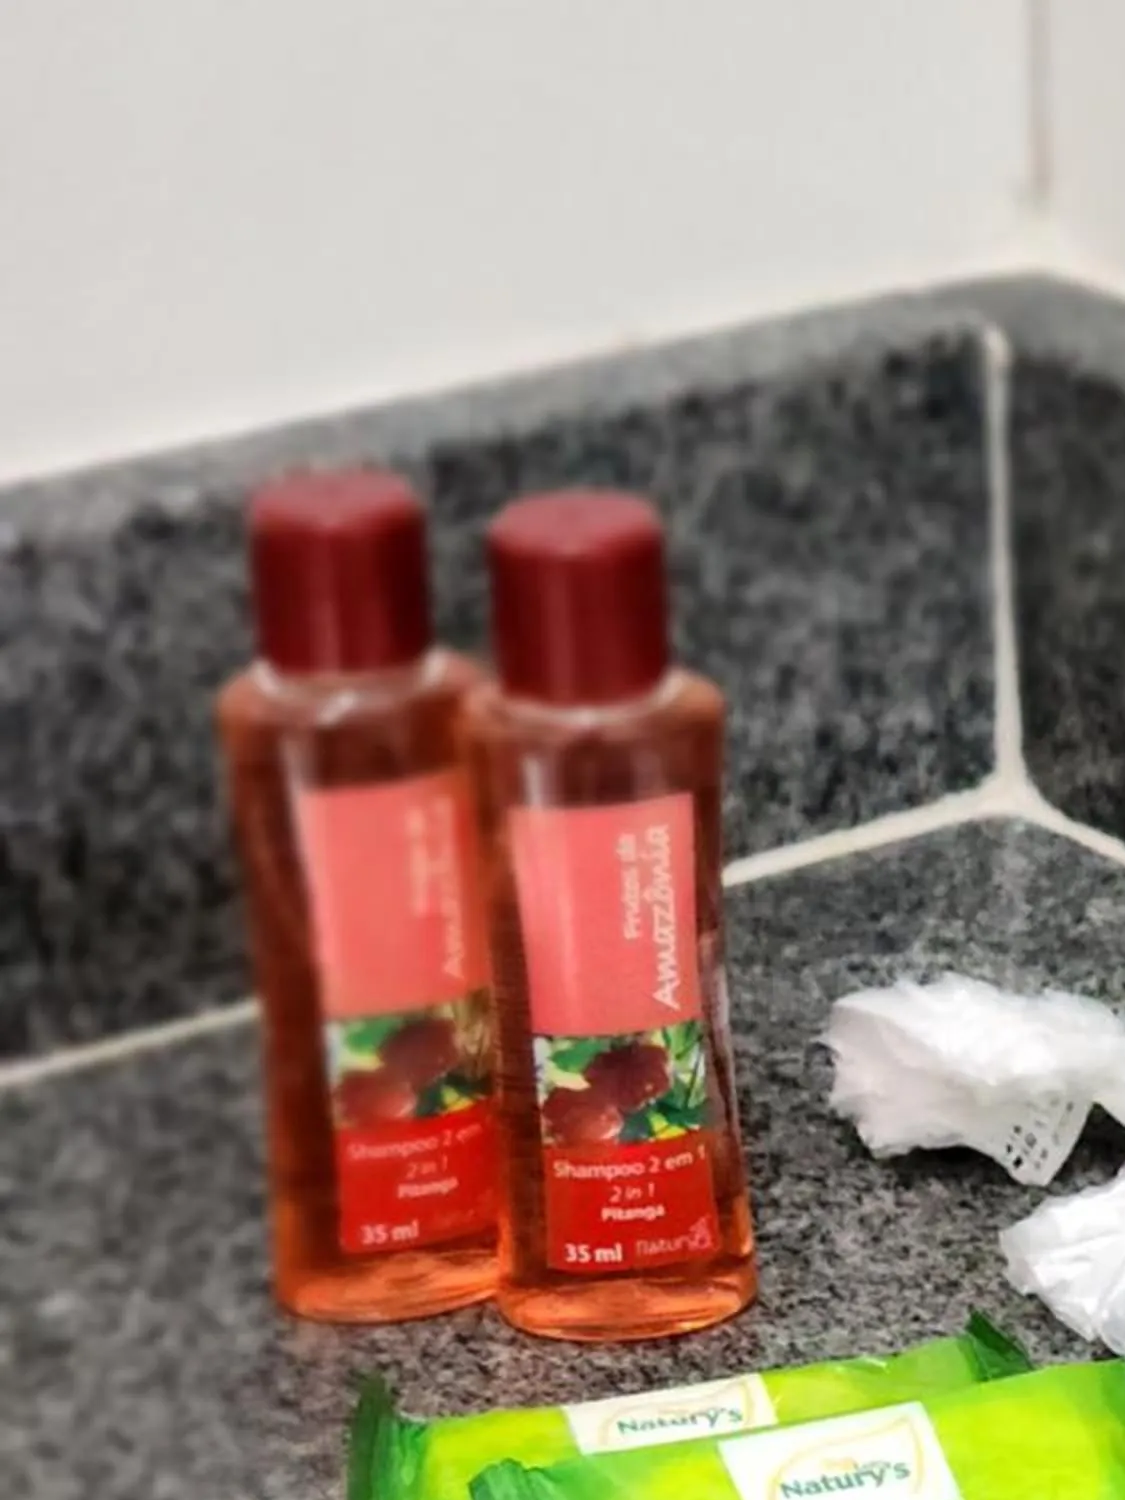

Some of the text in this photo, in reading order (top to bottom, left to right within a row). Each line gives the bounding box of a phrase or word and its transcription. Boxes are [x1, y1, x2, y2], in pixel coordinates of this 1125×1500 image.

[553, 1159, 646, 1183] Shampoo
[649, 1155, 661, 1174] 2
[664, 1151, 694, 1171] em
[609, 1185, 622, 1203] 2
[625, 1185, 642, 1200] in
[601, 1203, 666, 1222] Pitanga
[360, 1218, 419, 1245] 35 ml
[564, 1242, 622, 1263] 35 ml
[616, 1406, 744, 1435] Natury's
[780, 1460, 911, 1499] Natury's
